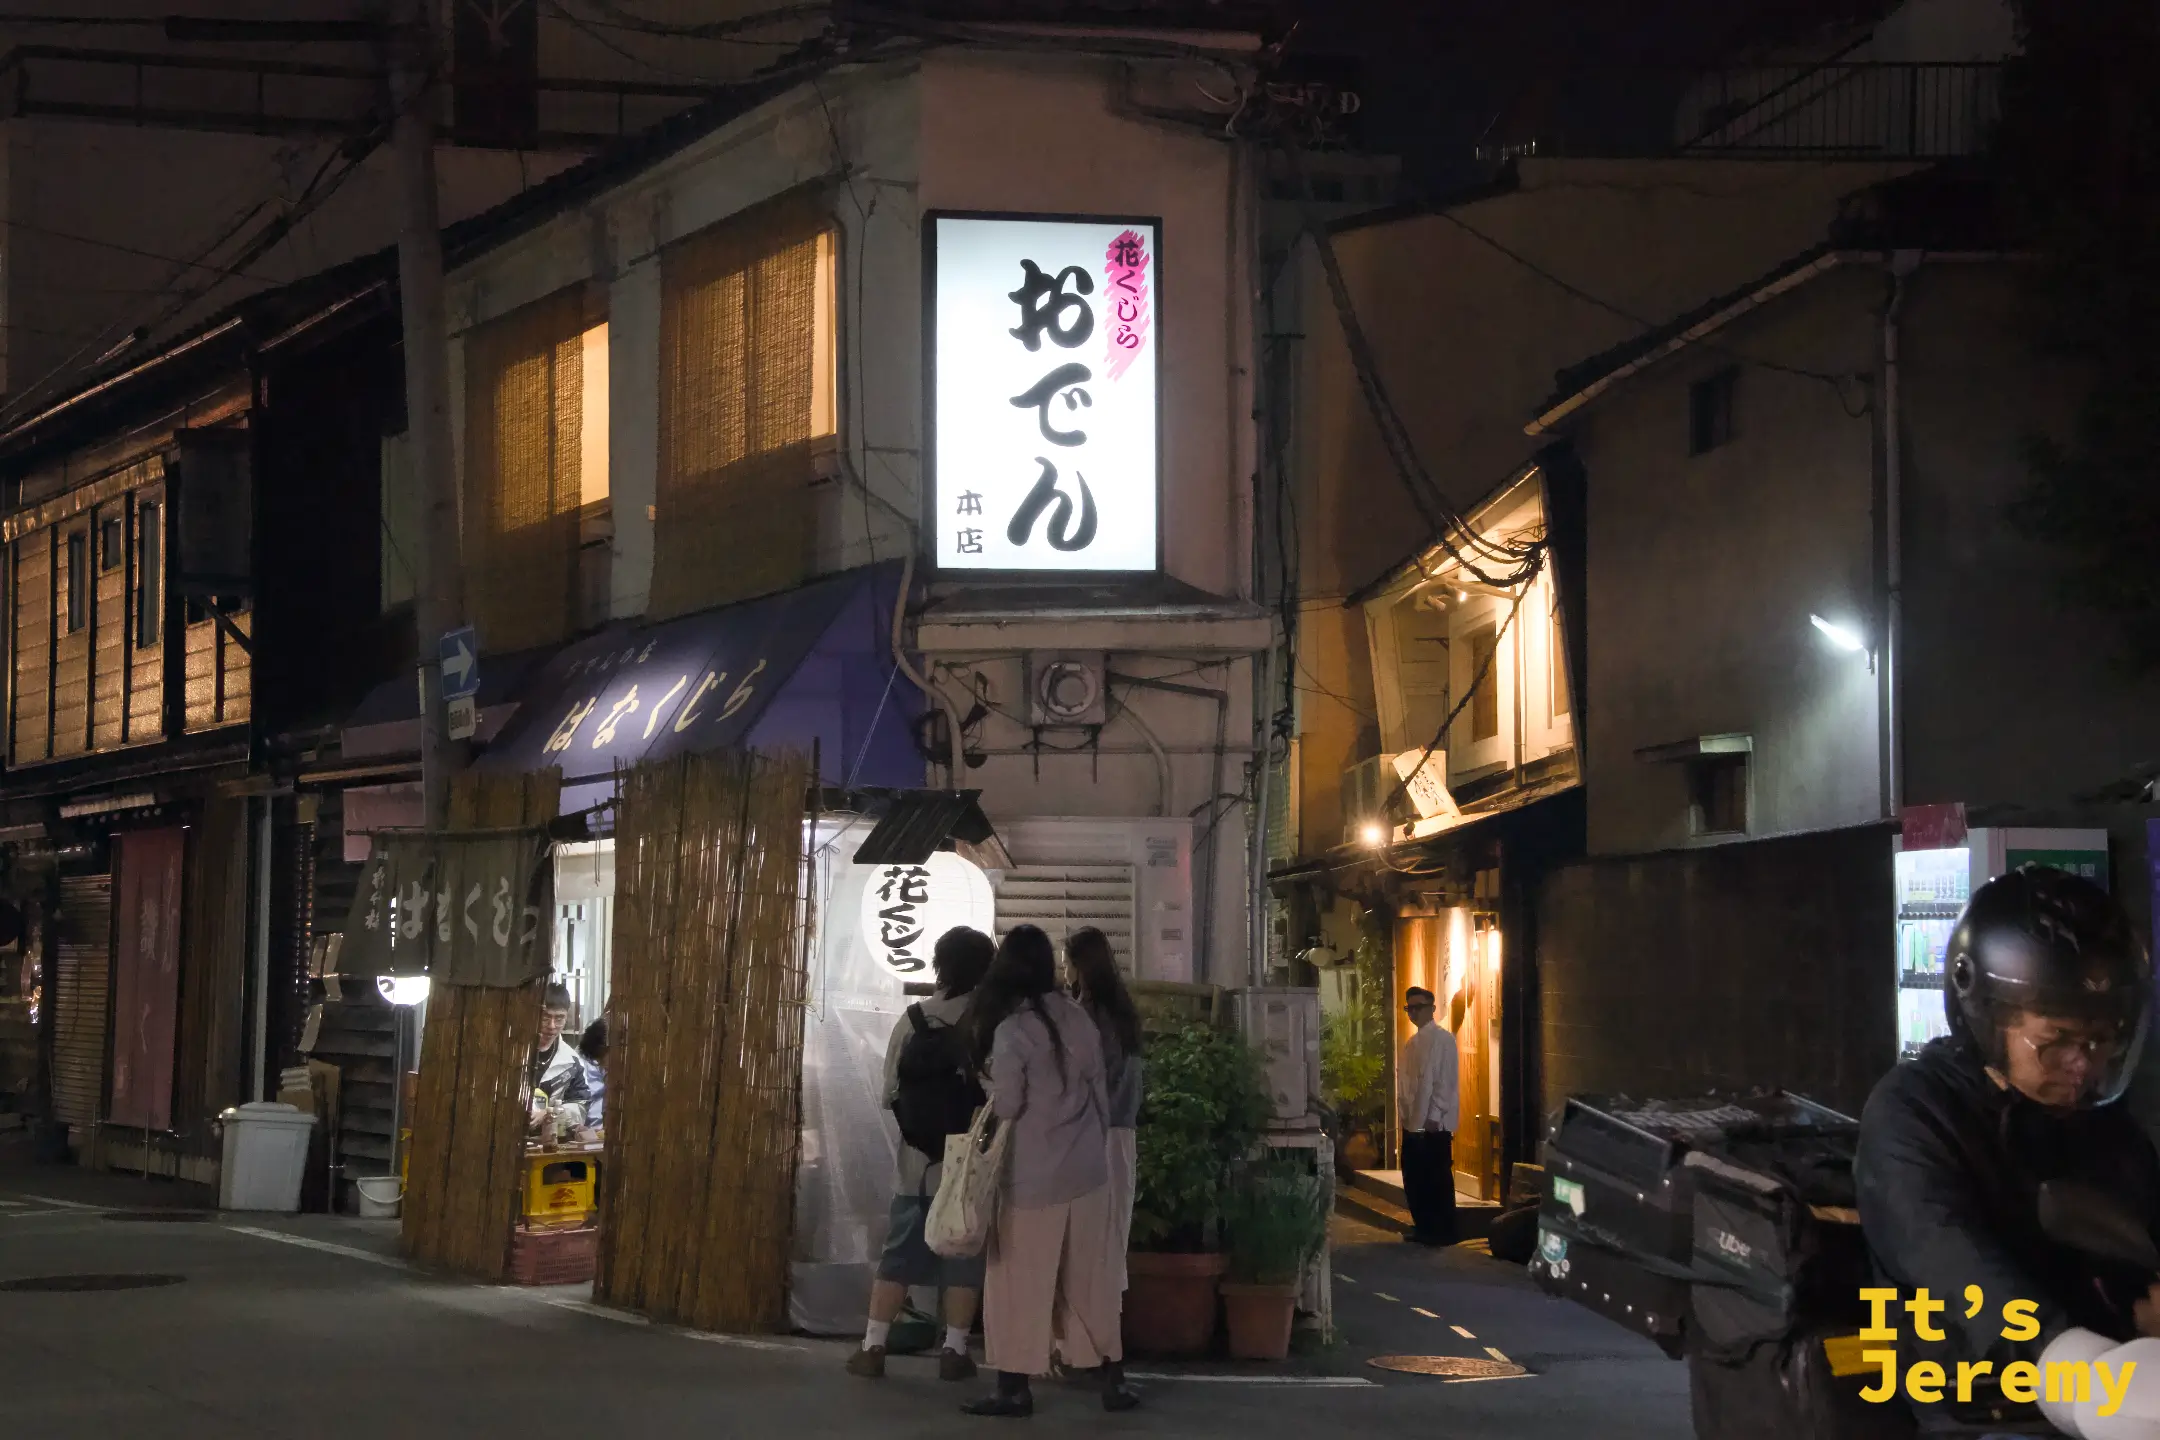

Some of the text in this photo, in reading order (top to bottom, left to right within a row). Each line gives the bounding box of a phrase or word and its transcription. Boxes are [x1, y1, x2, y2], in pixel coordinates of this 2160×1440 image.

[1114, 240, 1139, 349] 花くじら
[1007, 259, 1098, 552] おでん
[956, 490, 984, 554] 本店
[542, 658, 767, 754] はなくじら
[875, 866, 931, 972] 花くじら
